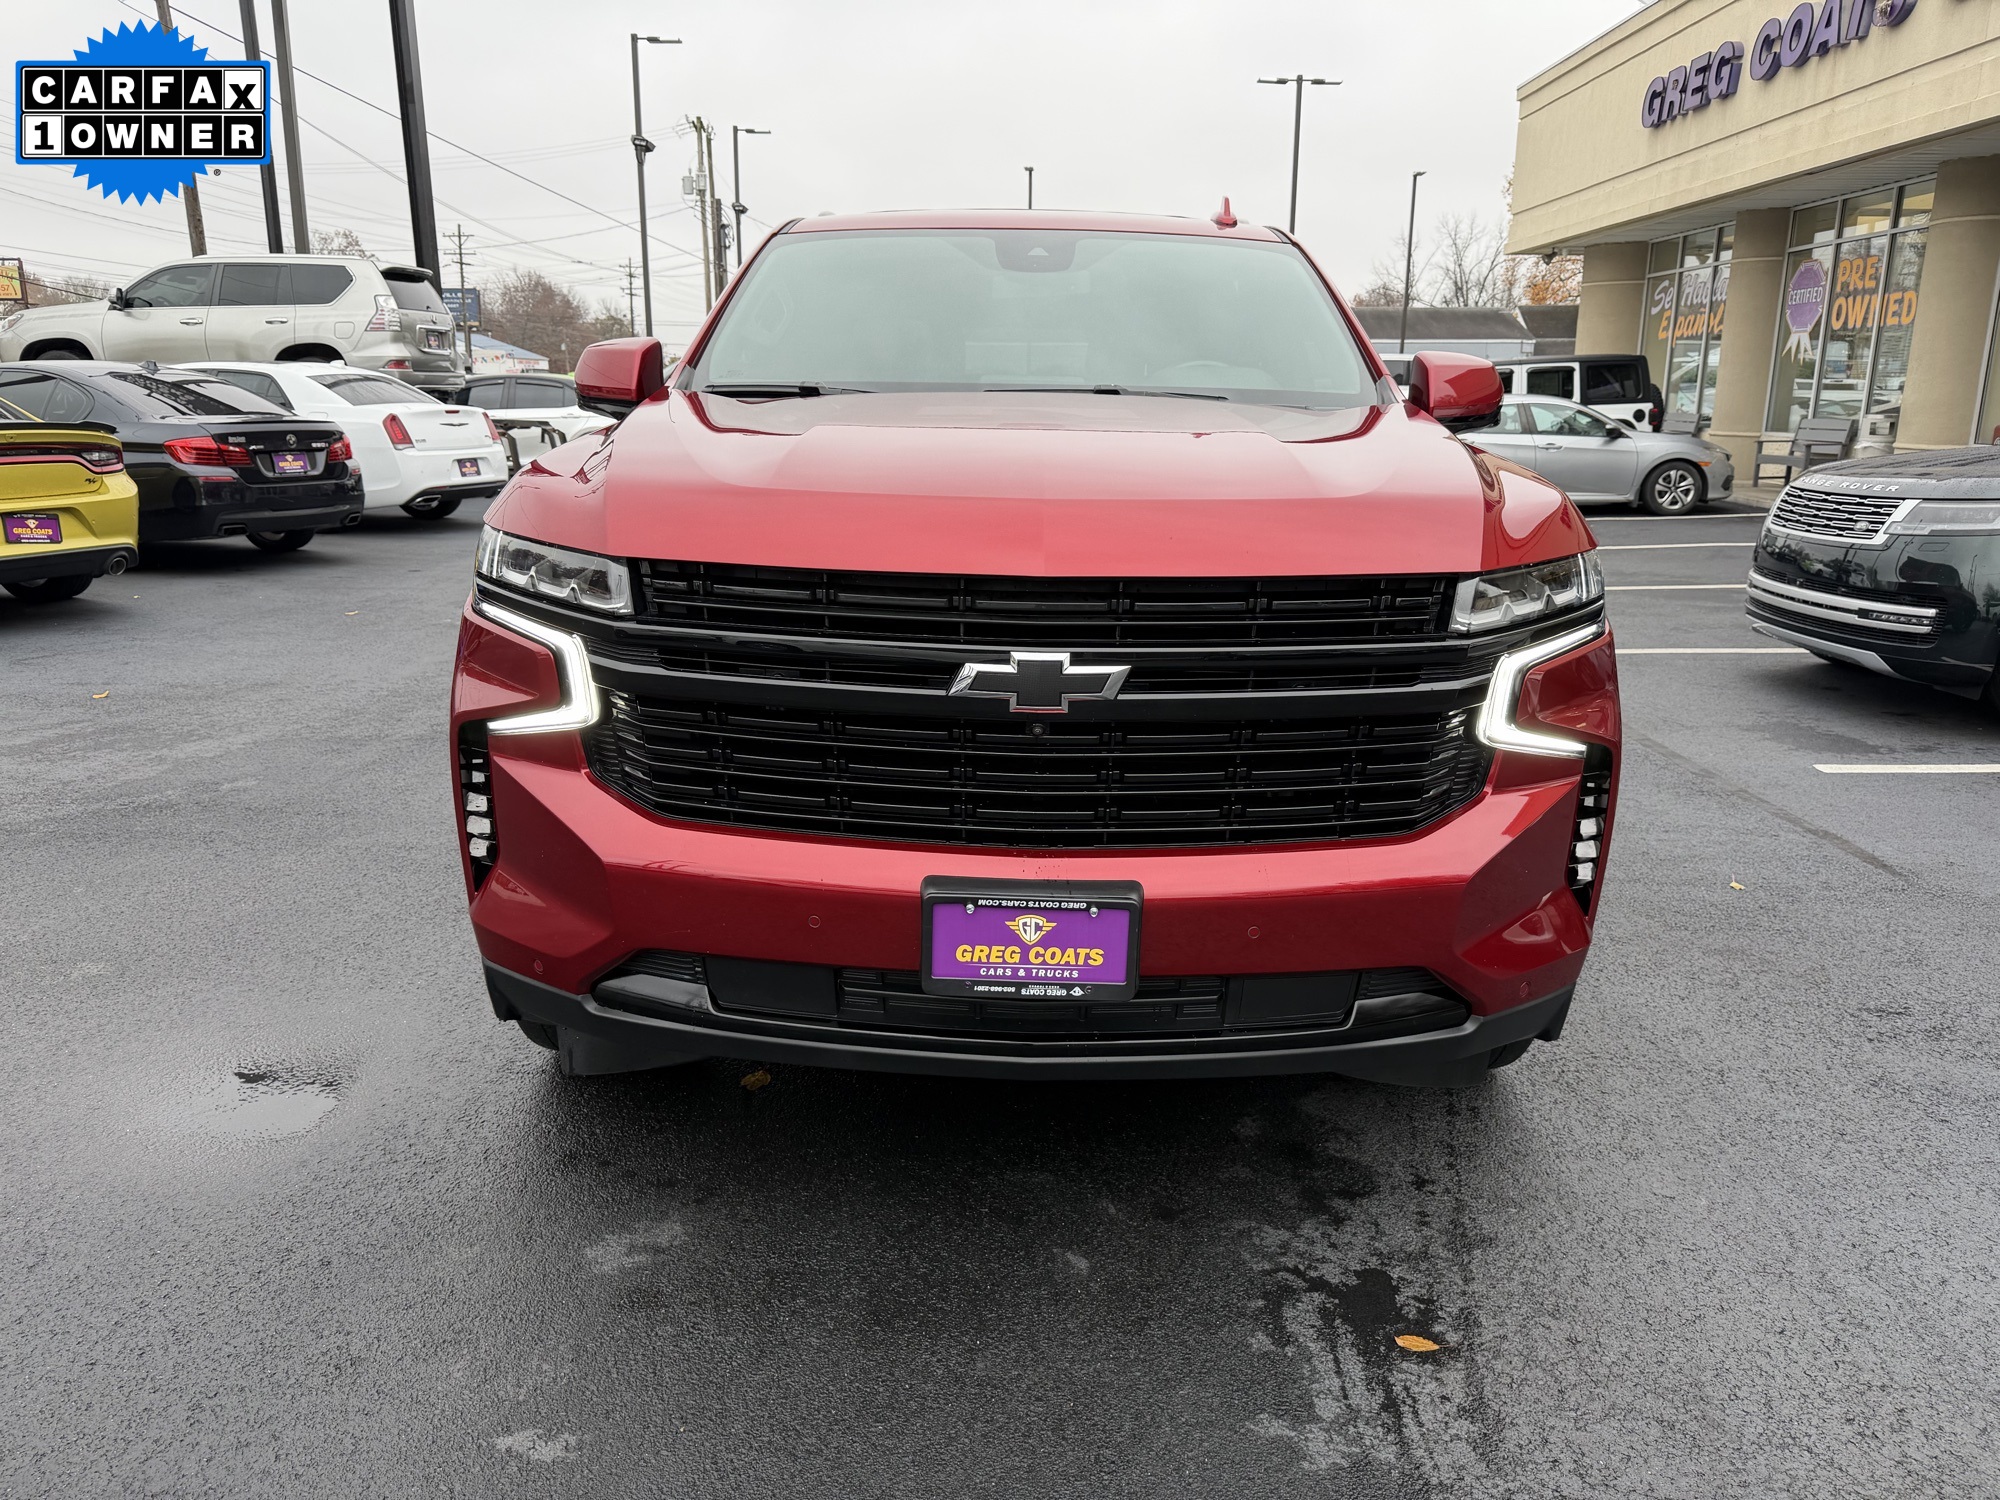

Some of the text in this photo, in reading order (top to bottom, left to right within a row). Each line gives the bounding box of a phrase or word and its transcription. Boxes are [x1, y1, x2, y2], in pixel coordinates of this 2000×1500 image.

[1641, 40, 1745, 128] GREG
[1650, 279, 1674, 316] Se
[1788, 286, 1823, 305] CERTIFIED
[1831, 290, 1918, 331] OWNED
[1839, 481, 1900, 492] ROVER
[955, 944, 1104, 966] GREG COATS
[980, 967, 1079, 978] CARS & TRUCKS
[1021, 988, 1045, 996] COATS
